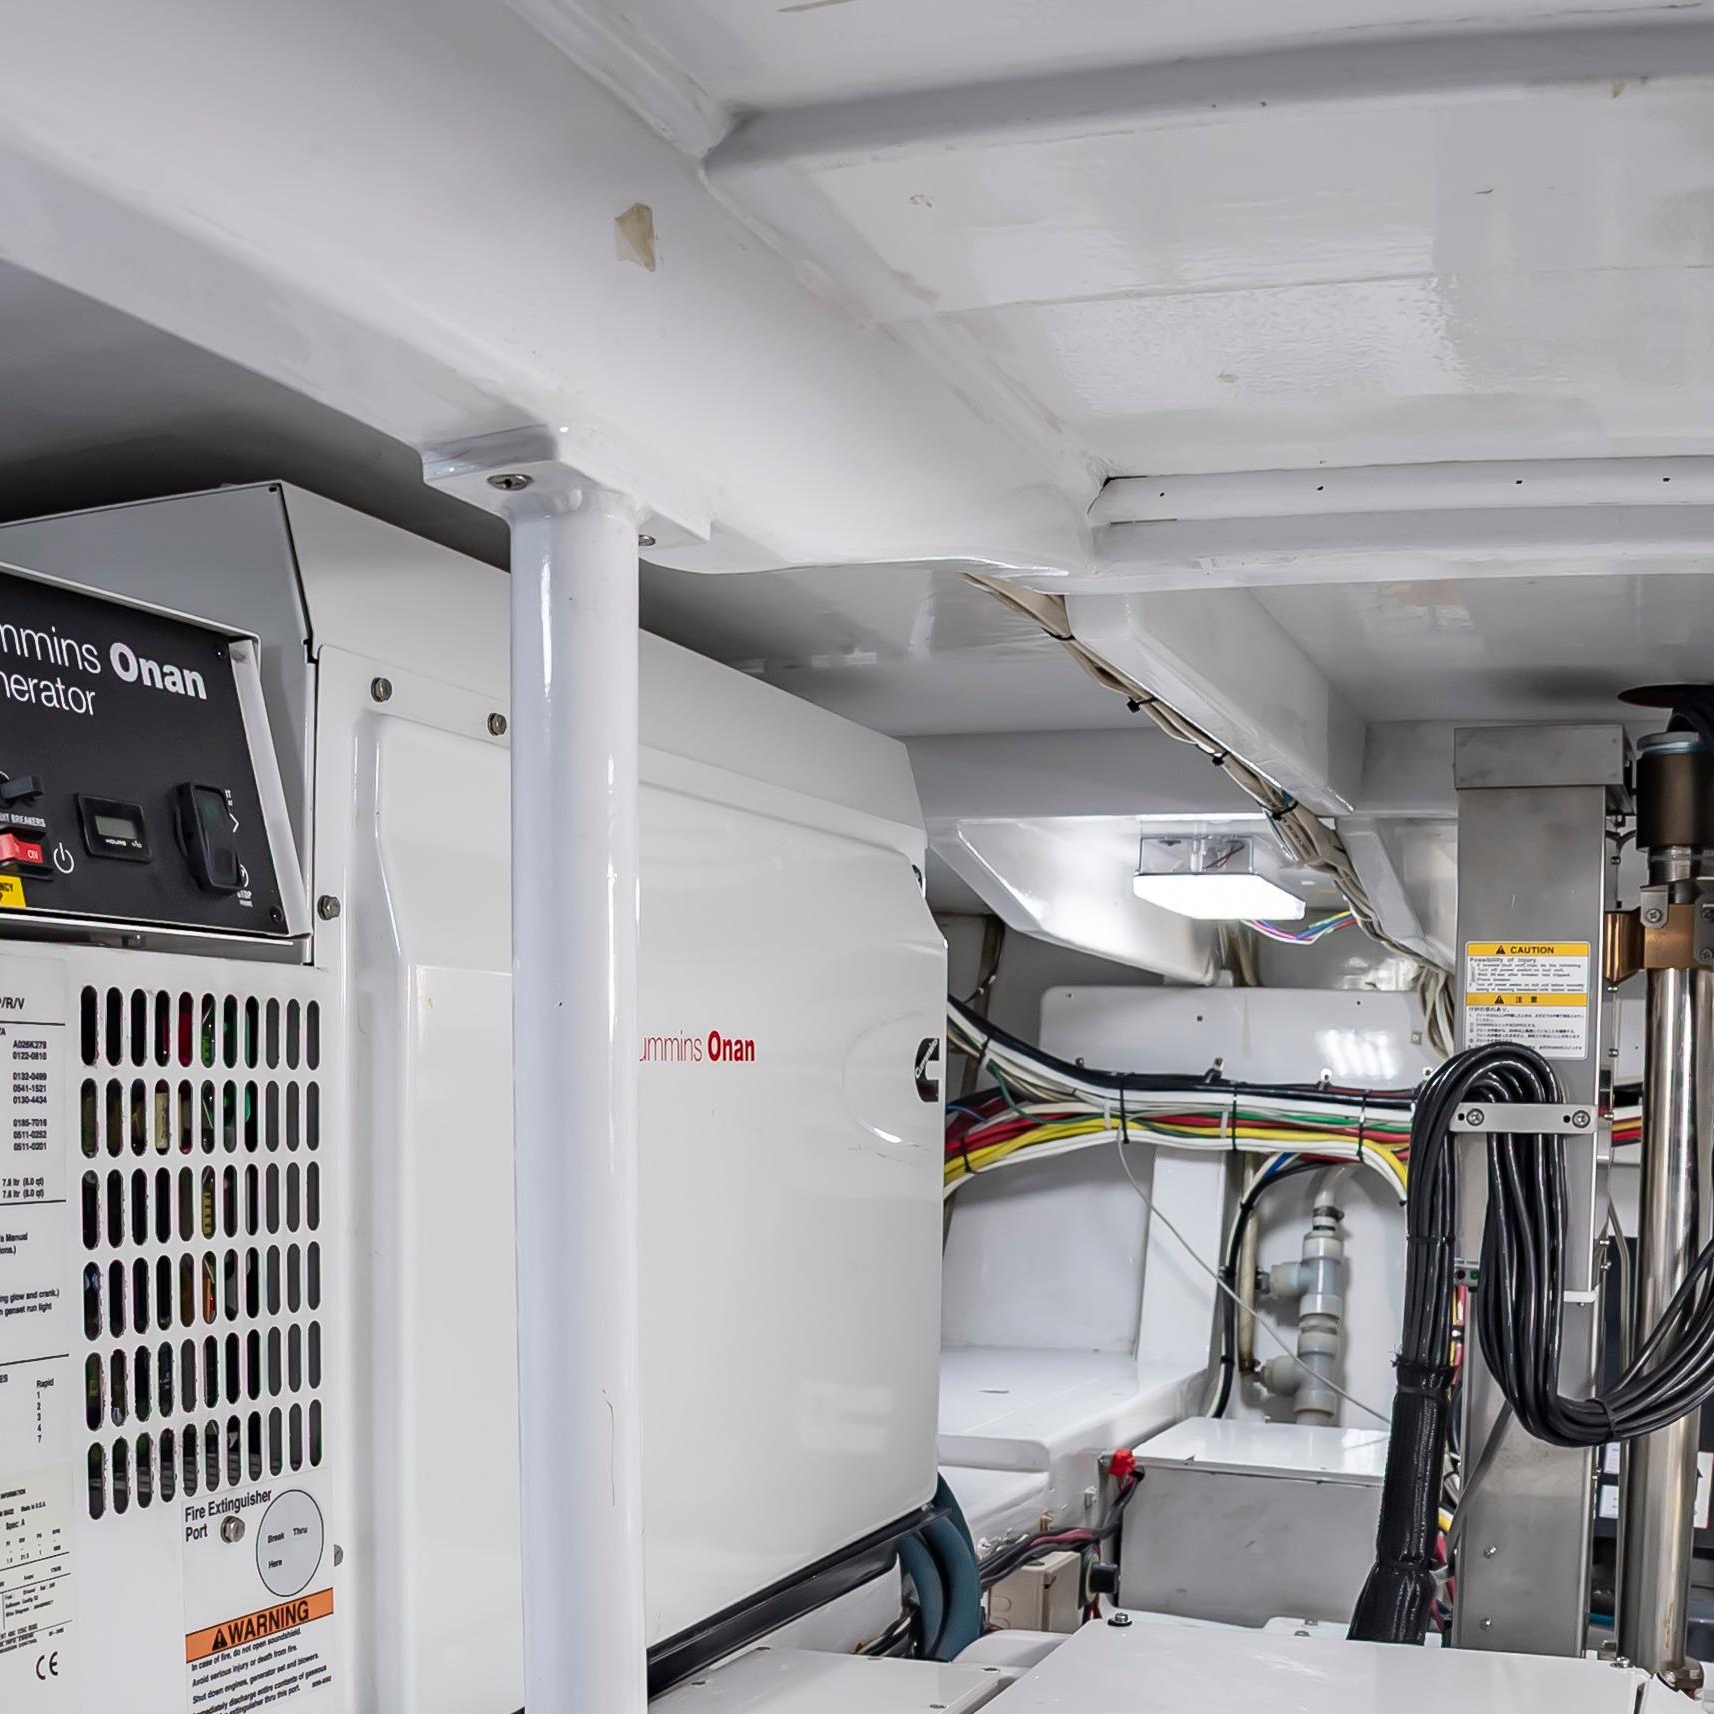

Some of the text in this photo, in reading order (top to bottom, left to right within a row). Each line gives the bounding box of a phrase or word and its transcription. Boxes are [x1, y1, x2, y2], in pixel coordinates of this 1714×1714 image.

[109, 642, 207, 700] Onan
[11, 814, 46, 828] BREAKERS
[28, 850, 38, 859] ON
[1510, 946, 1555, 954] CAUTION
[707, 1030, 755, 1062] Onan
[37, 1378, 54, 1388] Rapid
[185, 1488, 272, 1523] Fire Extinguisher
[186, 1523, 208, 1542] Port
[268, 1526, 308, 1544] Break Thru
[228, 1600, 309, 1645] WARNING
[192, 1676, 209, 1687] Avoid
[210, 1668, 231, 1680] serious
[233, 1662, 248, 1673] injury
[257, 1653, 272, 1664] death
[273, 1648, 286, 1658] from
[199, 1658, 213, 1670] case
[214, 1656, 220, 1664] of
[233, 1649, 241, 1657] do
[242, 1645, 251, 1654] not
[252, 1640, 266, 1651] open
[193, 1693, 206, 1704] Shut
[207, 1688, 223, 1699] down
[249, 1668, 276, 1685] generator
[287, 1660, 296, 1669] and
[229, 1692, 256, 1707] discharge
[257, 1684, 273, 1696] entire
[274, 1675, 297, 1689] contents
[299, 1672, 304, 1680] of
[305, 1665, 327, 1680] gaseous
[265, 1694, 276, 1703] thru
[277, 1690, 287, 1699] this
